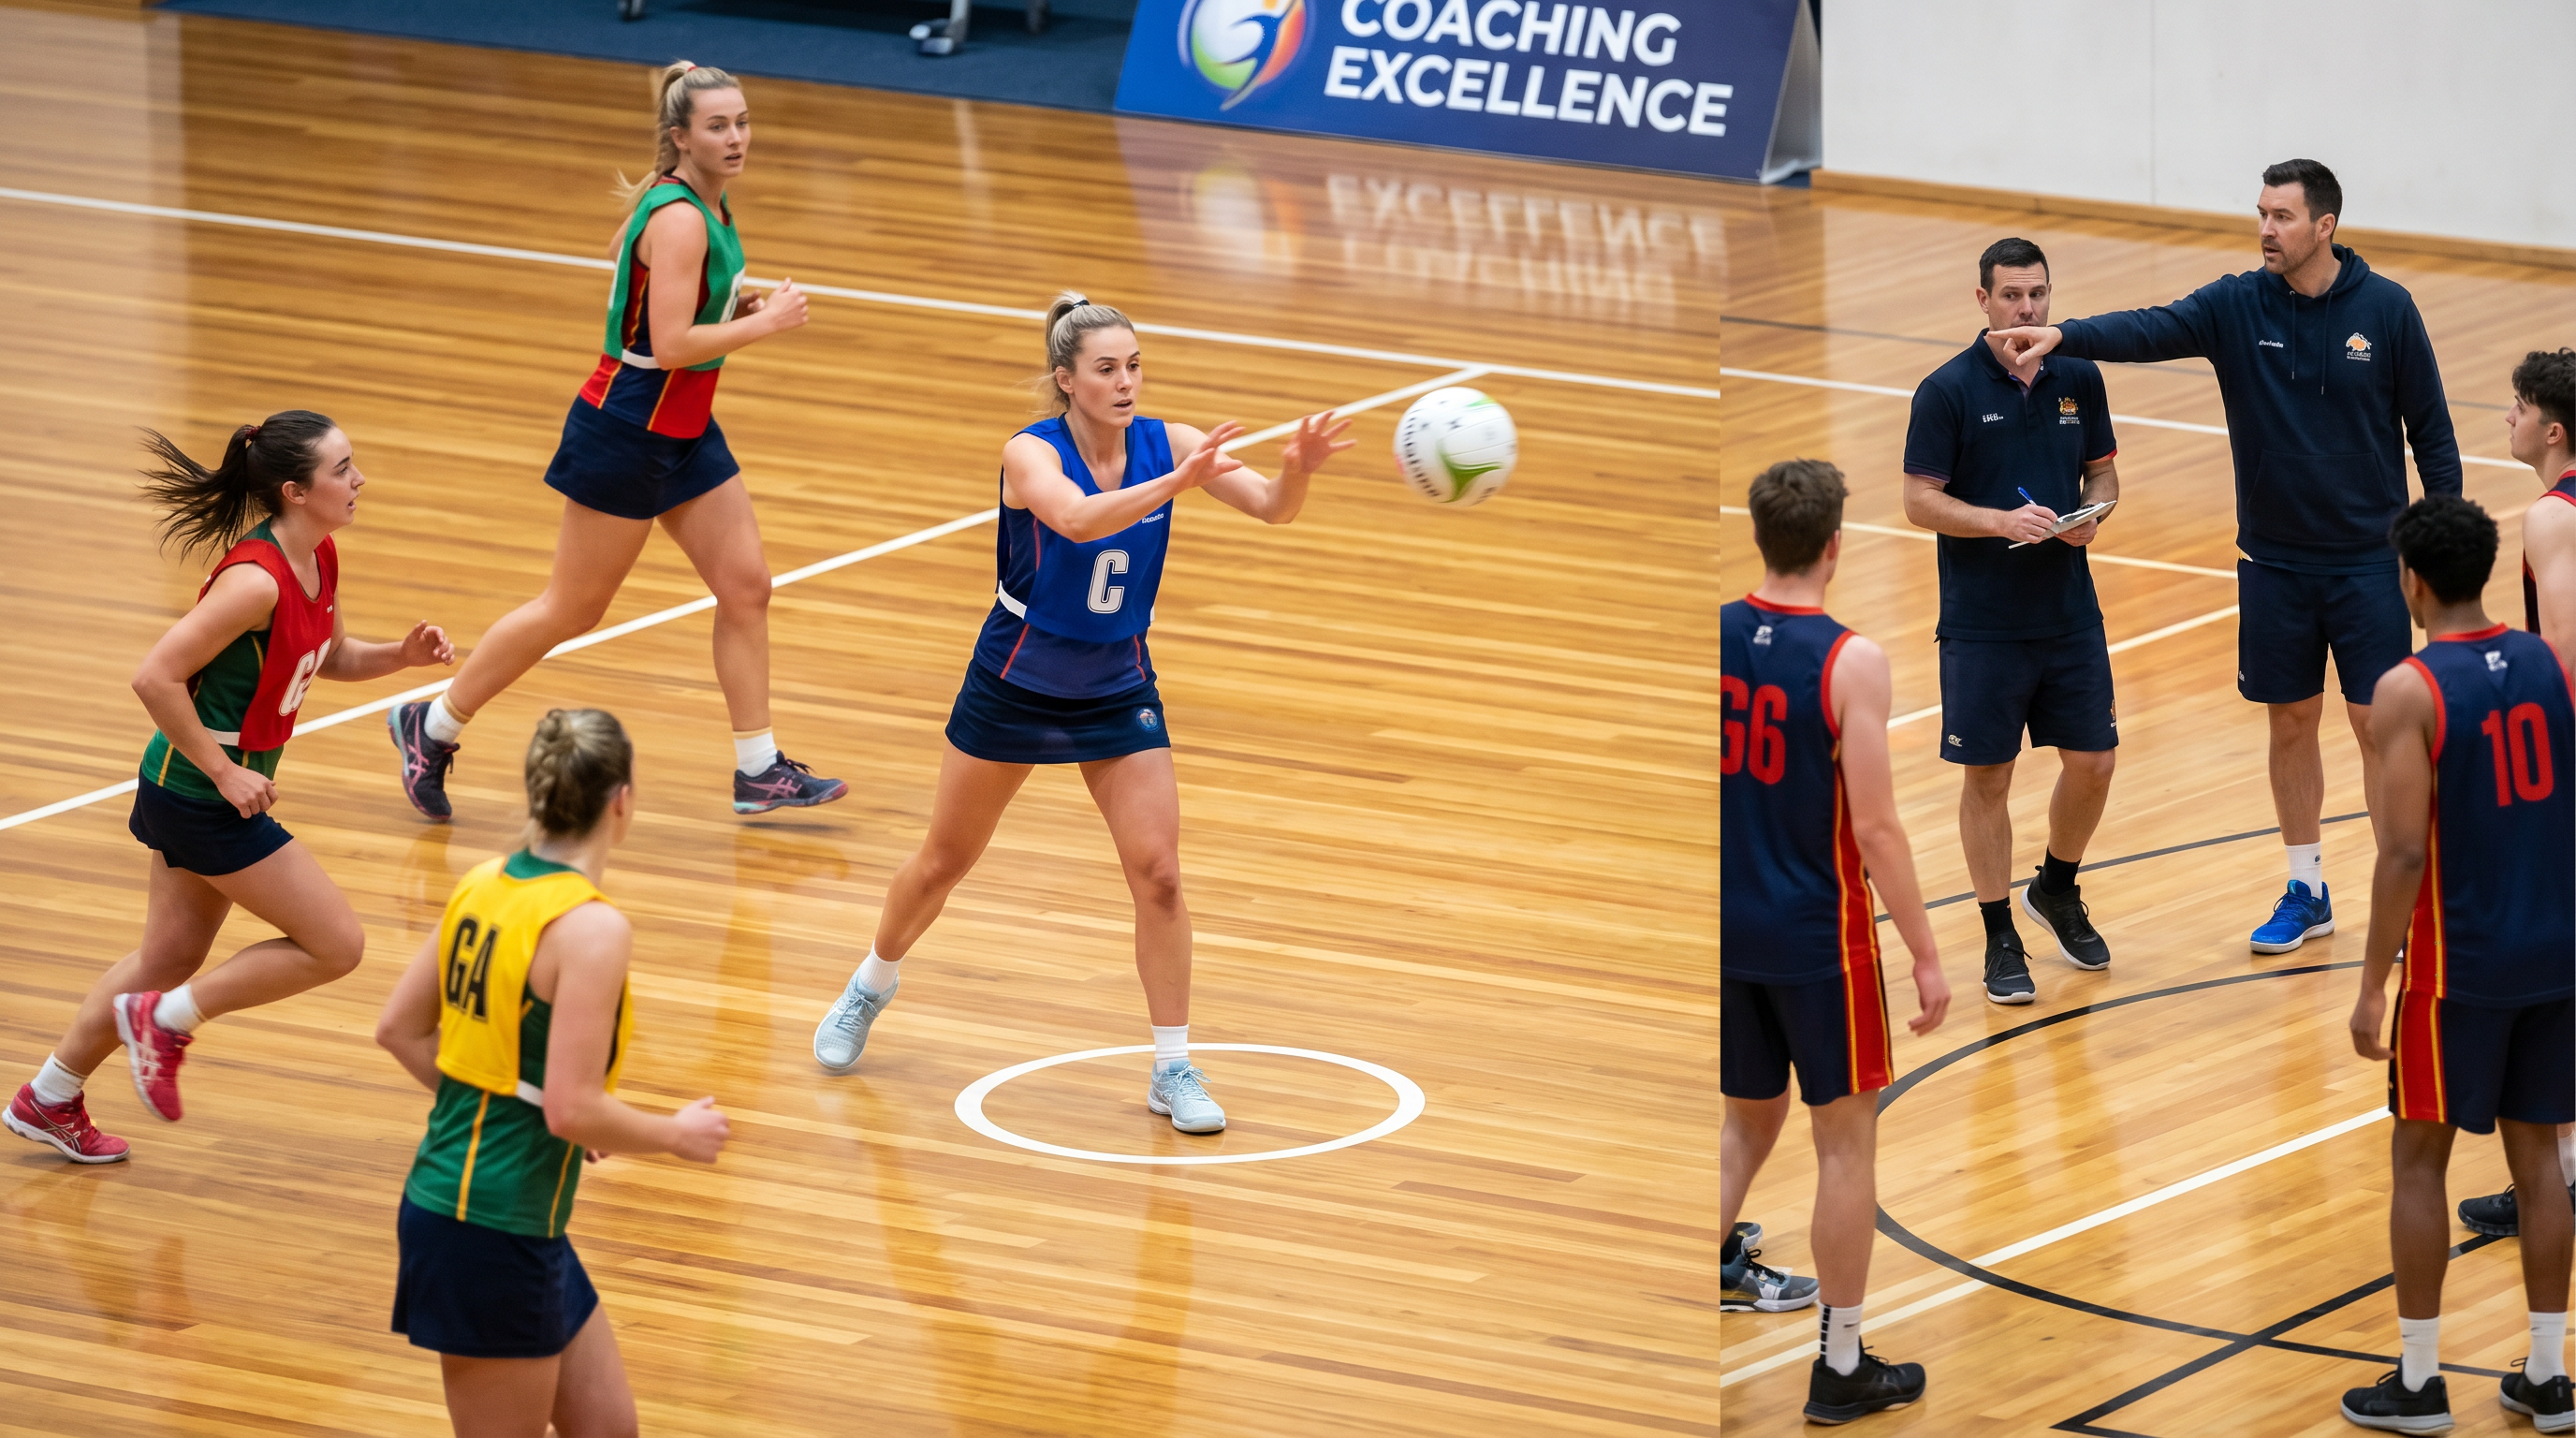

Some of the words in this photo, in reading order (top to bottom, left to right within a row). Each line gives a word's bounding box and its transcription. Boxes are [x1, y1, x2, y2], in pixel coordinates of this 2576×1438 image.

[1340, 0, 1682, 66] COACHING
[1324, 45, 1734, 137] EXCELLENCE
[1087, 549, 1129, 614] C
[2481, 701, 2554, 807] 10
[445, 912, 501, 1024] GA
